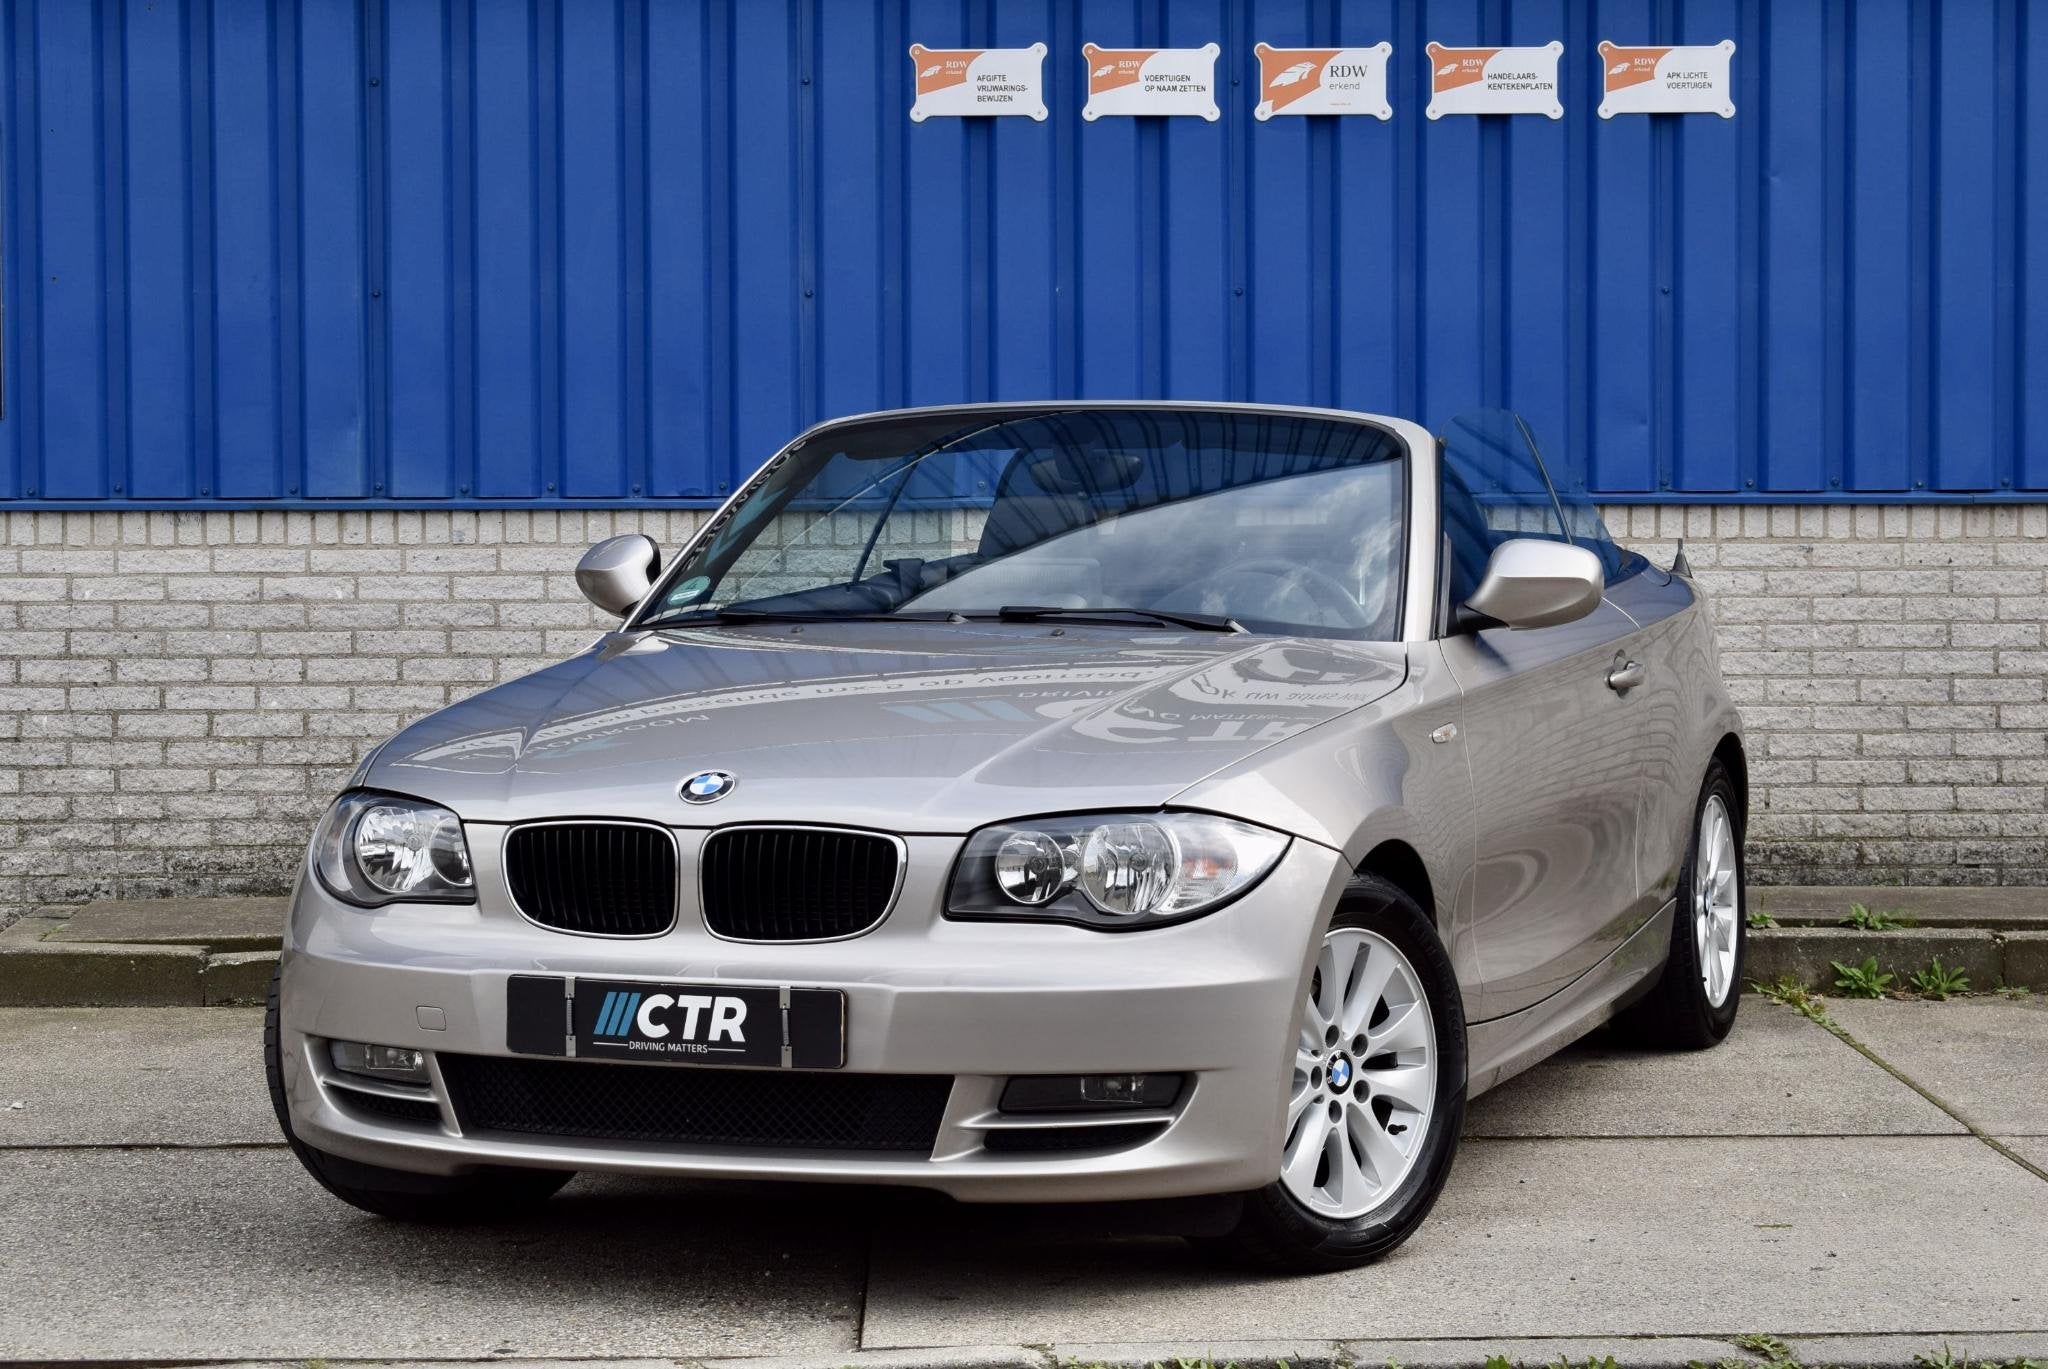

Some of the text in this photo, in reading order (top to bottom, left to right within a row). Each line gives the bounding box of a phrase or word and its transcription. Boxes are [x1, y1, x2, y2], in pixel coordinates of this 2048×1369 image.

[945, 60, 968, 68] RDW
[1119, 60, 1141, 68] RDW
[1462, 58, 1485, 67] RDW
[1634, 57, 1657, 66] RDW
[1329, 64, 1368, 78] RDW
[1666, 71, 1708, 79] APK LICHTE
[976, 74, 1007, 82] AFGIFTE
[1144, 74, 1191, 82] VOERTUIGEN
[1487, 72, 1538, 80] HANDELAARS-
[976, 84, 1028, 92] VRIJWARINGS-
[1144, 84, 1207, 92] OP NAAM ZETTEN
[1329, 81, 1360, 90] erkend
[1487, 82, 1553, 90] KENTEKENPLATEN
[1666, 81, 1713, 89] VOERTUIGEN
[976, 94, 1013, 102] BEWIJZEN
[636, 993, 748, 1043] CTR
[629, 1041, 708, 1053] DRIVING MATTERS
